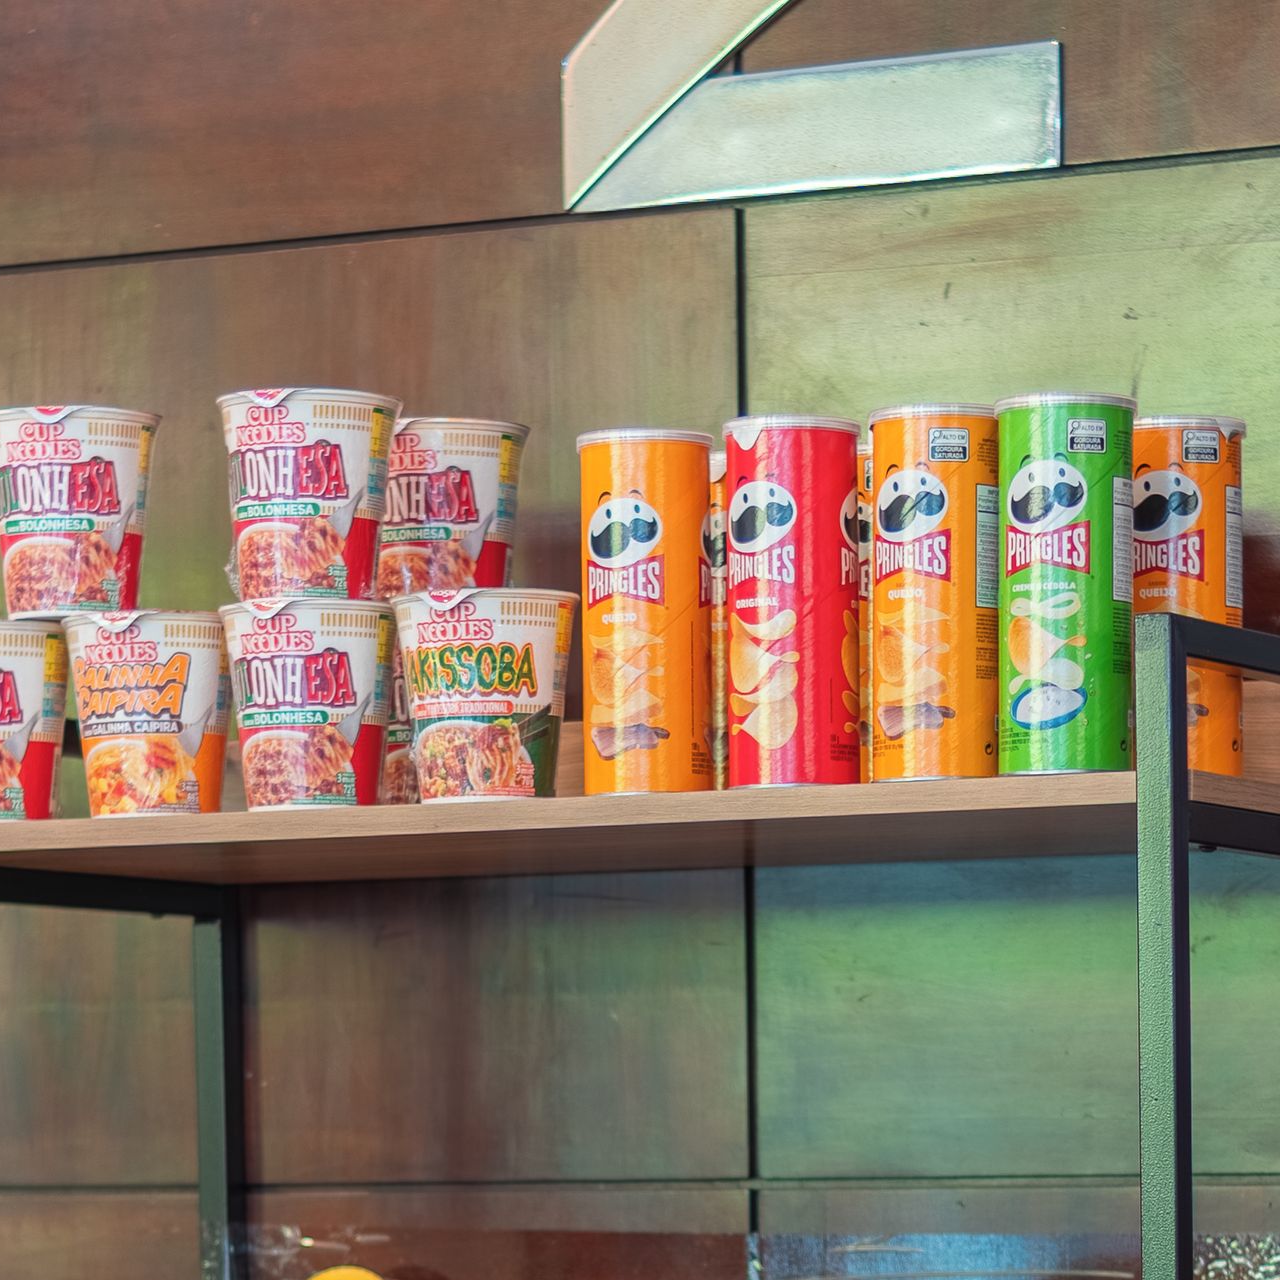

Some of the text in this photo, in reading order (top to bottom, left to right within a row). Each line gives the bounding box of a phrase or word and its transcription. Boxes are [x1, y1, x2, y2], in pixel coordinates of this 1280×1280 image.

[247, 405, 289, 425] CUP
[20, 423, 65, 441] CUP
[236, 422, 306, 446] NOODLES
[6, 439, 82, 462] NOODLES
[392, 434, 421, 454] UP
[231, 443, 349, 505] LONHESA
[248, 503, 315, 517] BOLONHESA
[20, 518, 90, 532] BOLONHESA
[876, 535, 947, 580] PRINGLES
[1007, 527, 1086, 571] PRINGLES
[1132, 535, 1200, 576] RINGLES
[728, 545, 795, 590] PRINGLES
[588, 561, 660, 604] PRINGLES
[1043, 582, 1077, 590] CEBOLA
[1140, 587, 1177, 599] QUEIJO
[735, 597, 780, 609] ORIGINAL
[888, 588, 923, 600] QUEIJO
[430, 601, 477, 622] CUP
[96, 624, 141, 645] CUP
[253, 613, 298, 634] CUP
[417, 618, 493, 644] NOODLES
[84, 641, 158, 665] NOODLES
[240, 630, 315, 655] NOODLES
[73, 652, 191, 692] GALINHA
[235, 651, 357, 712] LONHESA
[406, 642, 539, 700] AKISSOBA
[78, 684, 184, 721] CAIPIRA
[460, 701, 509, 714] TRADICIONAL
[91, 721, 178, 735] GALINHA CAIPIRA
[254, 711, 324, 725] BOLONHESA
